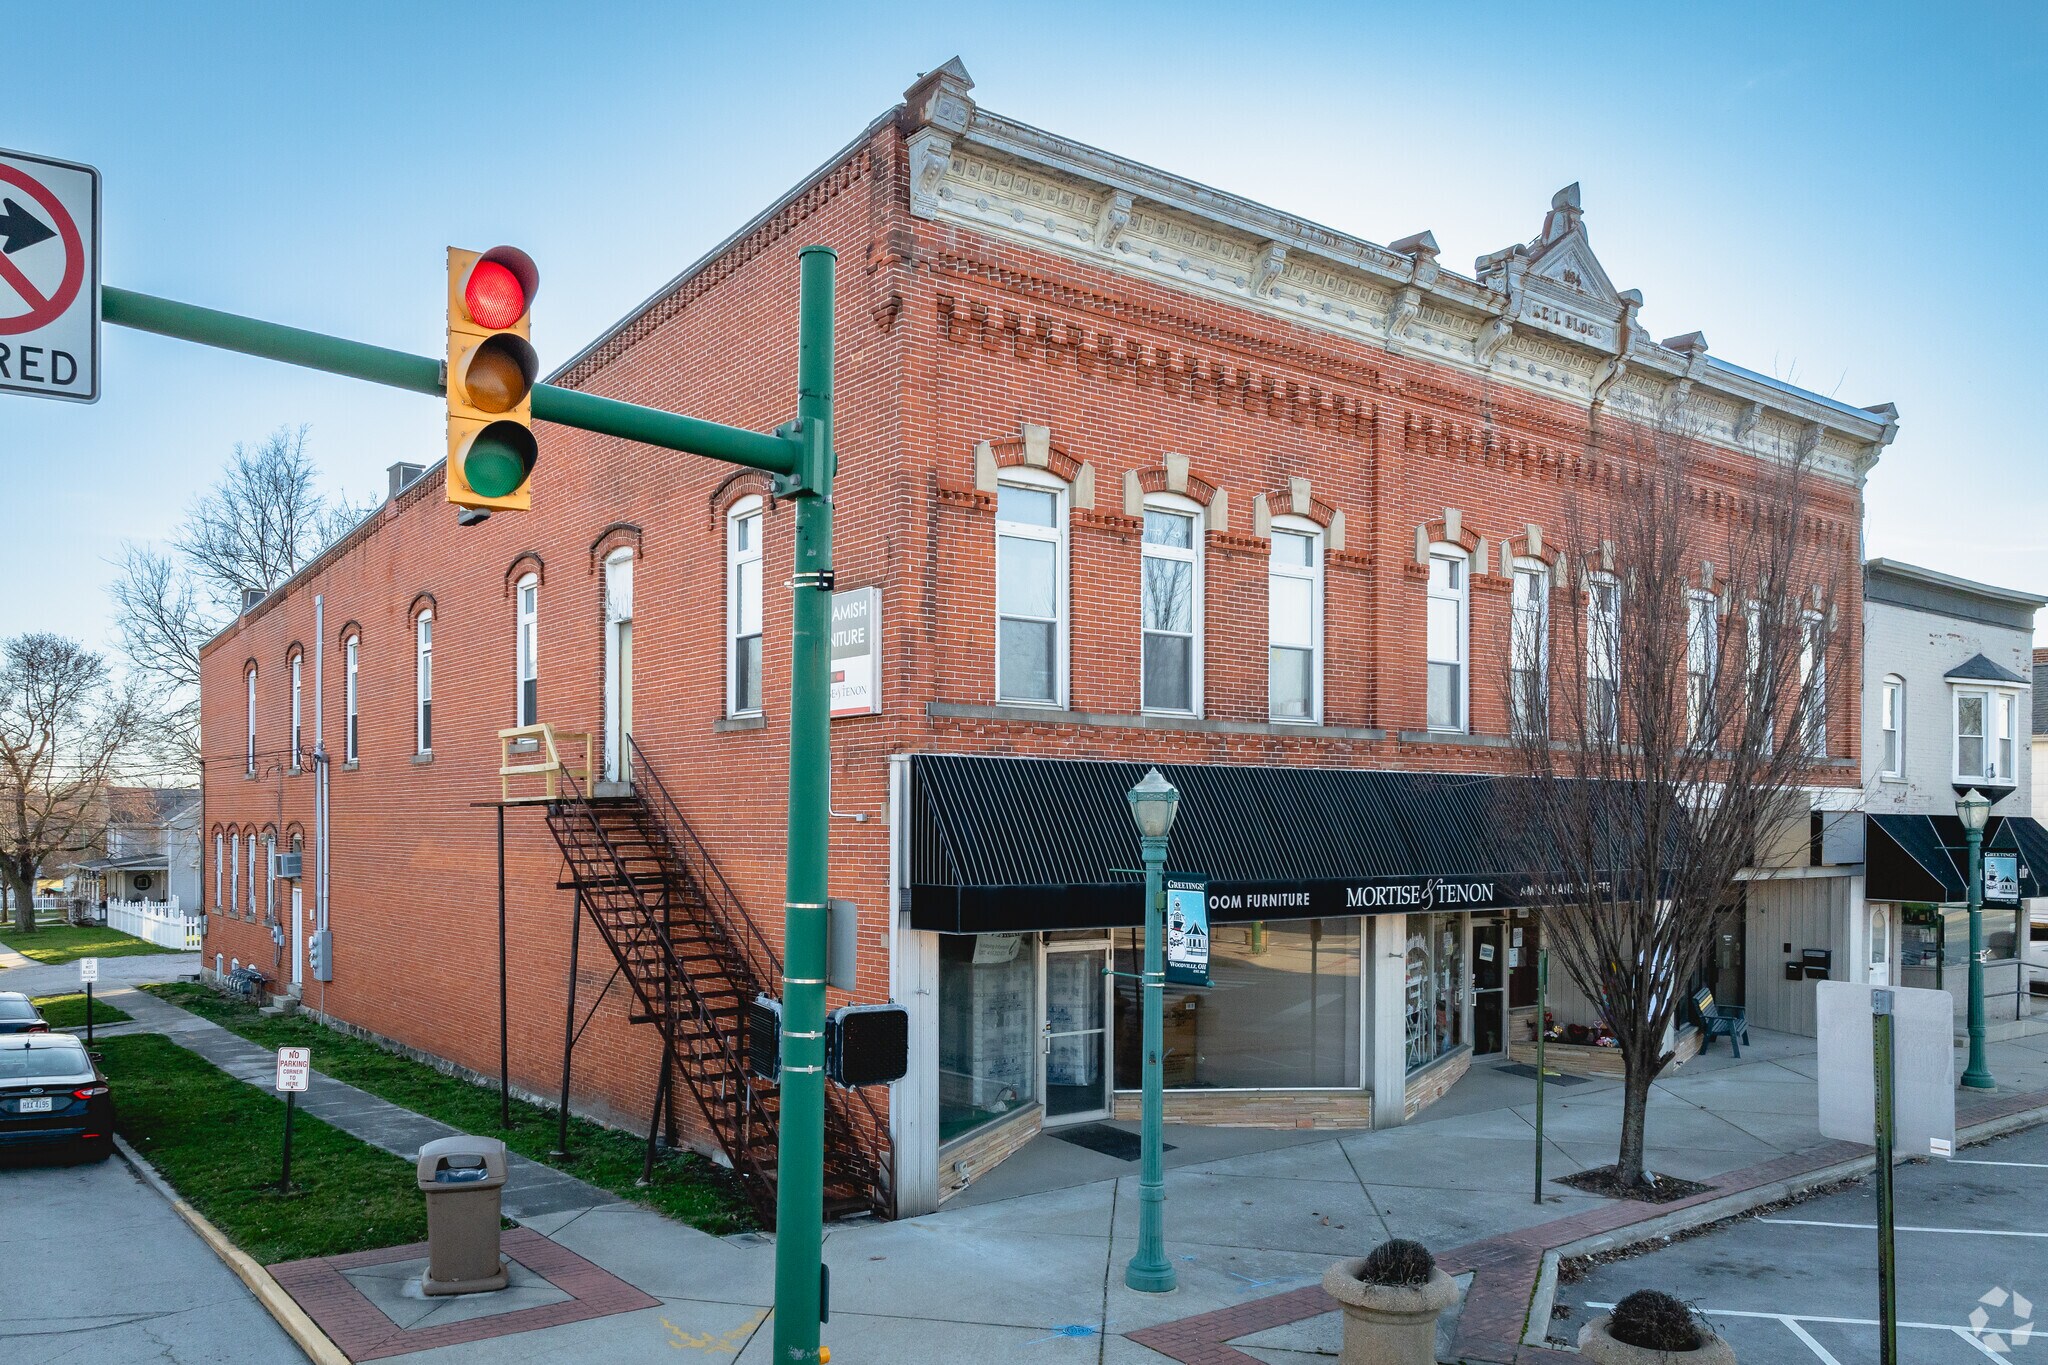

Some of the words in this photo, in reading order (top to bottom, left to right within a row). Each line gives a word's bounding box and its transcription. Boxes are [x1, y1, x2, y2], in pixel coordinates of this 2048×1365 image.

[831, 600, 867, 622] AMISH
[1167, 880, 1205, 891] GREETINGS!
[1209, 895, 1242, 910] OOM
[1246, 892, 1311, 908] FURNITURE
[1345, 885, 1421, 908] MORTISE
[1436, 883, 1495, 904] TENON
[289, 1051, 300, 1059] NO
[280, 1060, 308, 1068] PARKING
